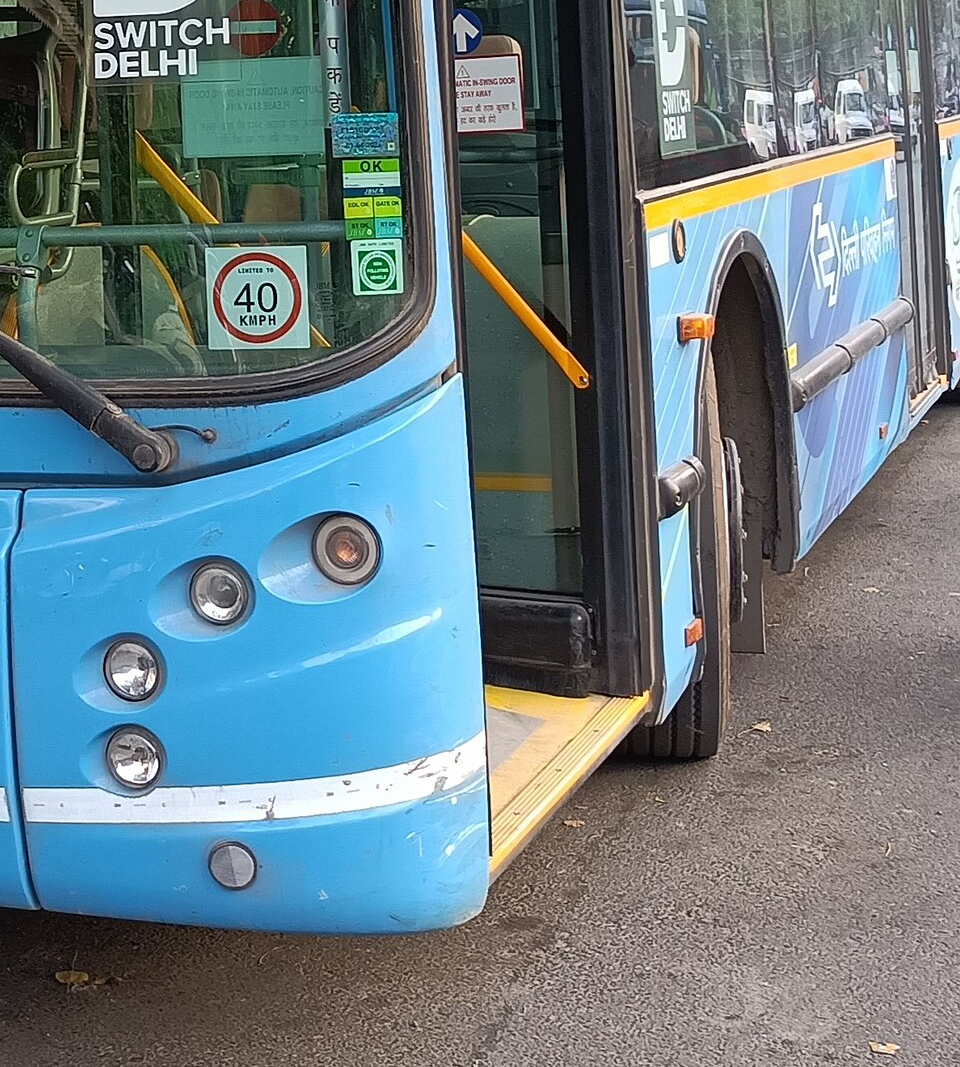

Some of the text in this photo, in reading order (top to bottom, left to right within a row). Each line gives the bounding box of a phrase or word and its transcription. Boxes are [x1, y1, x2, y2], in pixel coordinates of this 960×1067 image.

[94, 17, 230, 51] SWITCH
[94, 50, 199, 80] DELHI
[461, 91, 474, 99] STAY
[476, 90, 492, 98] AWAY
[473, 77, 498, 86] IN-SWING
[499, 77, 516, 85] DOOR
[662, 89, 690, 115] SWITCH
[663, 116, 687, 142] DELHI
[360, 161, 383, 173] OK
[233, 282, 278, 313] 40
[240, 315, 276, 326] KMPH
